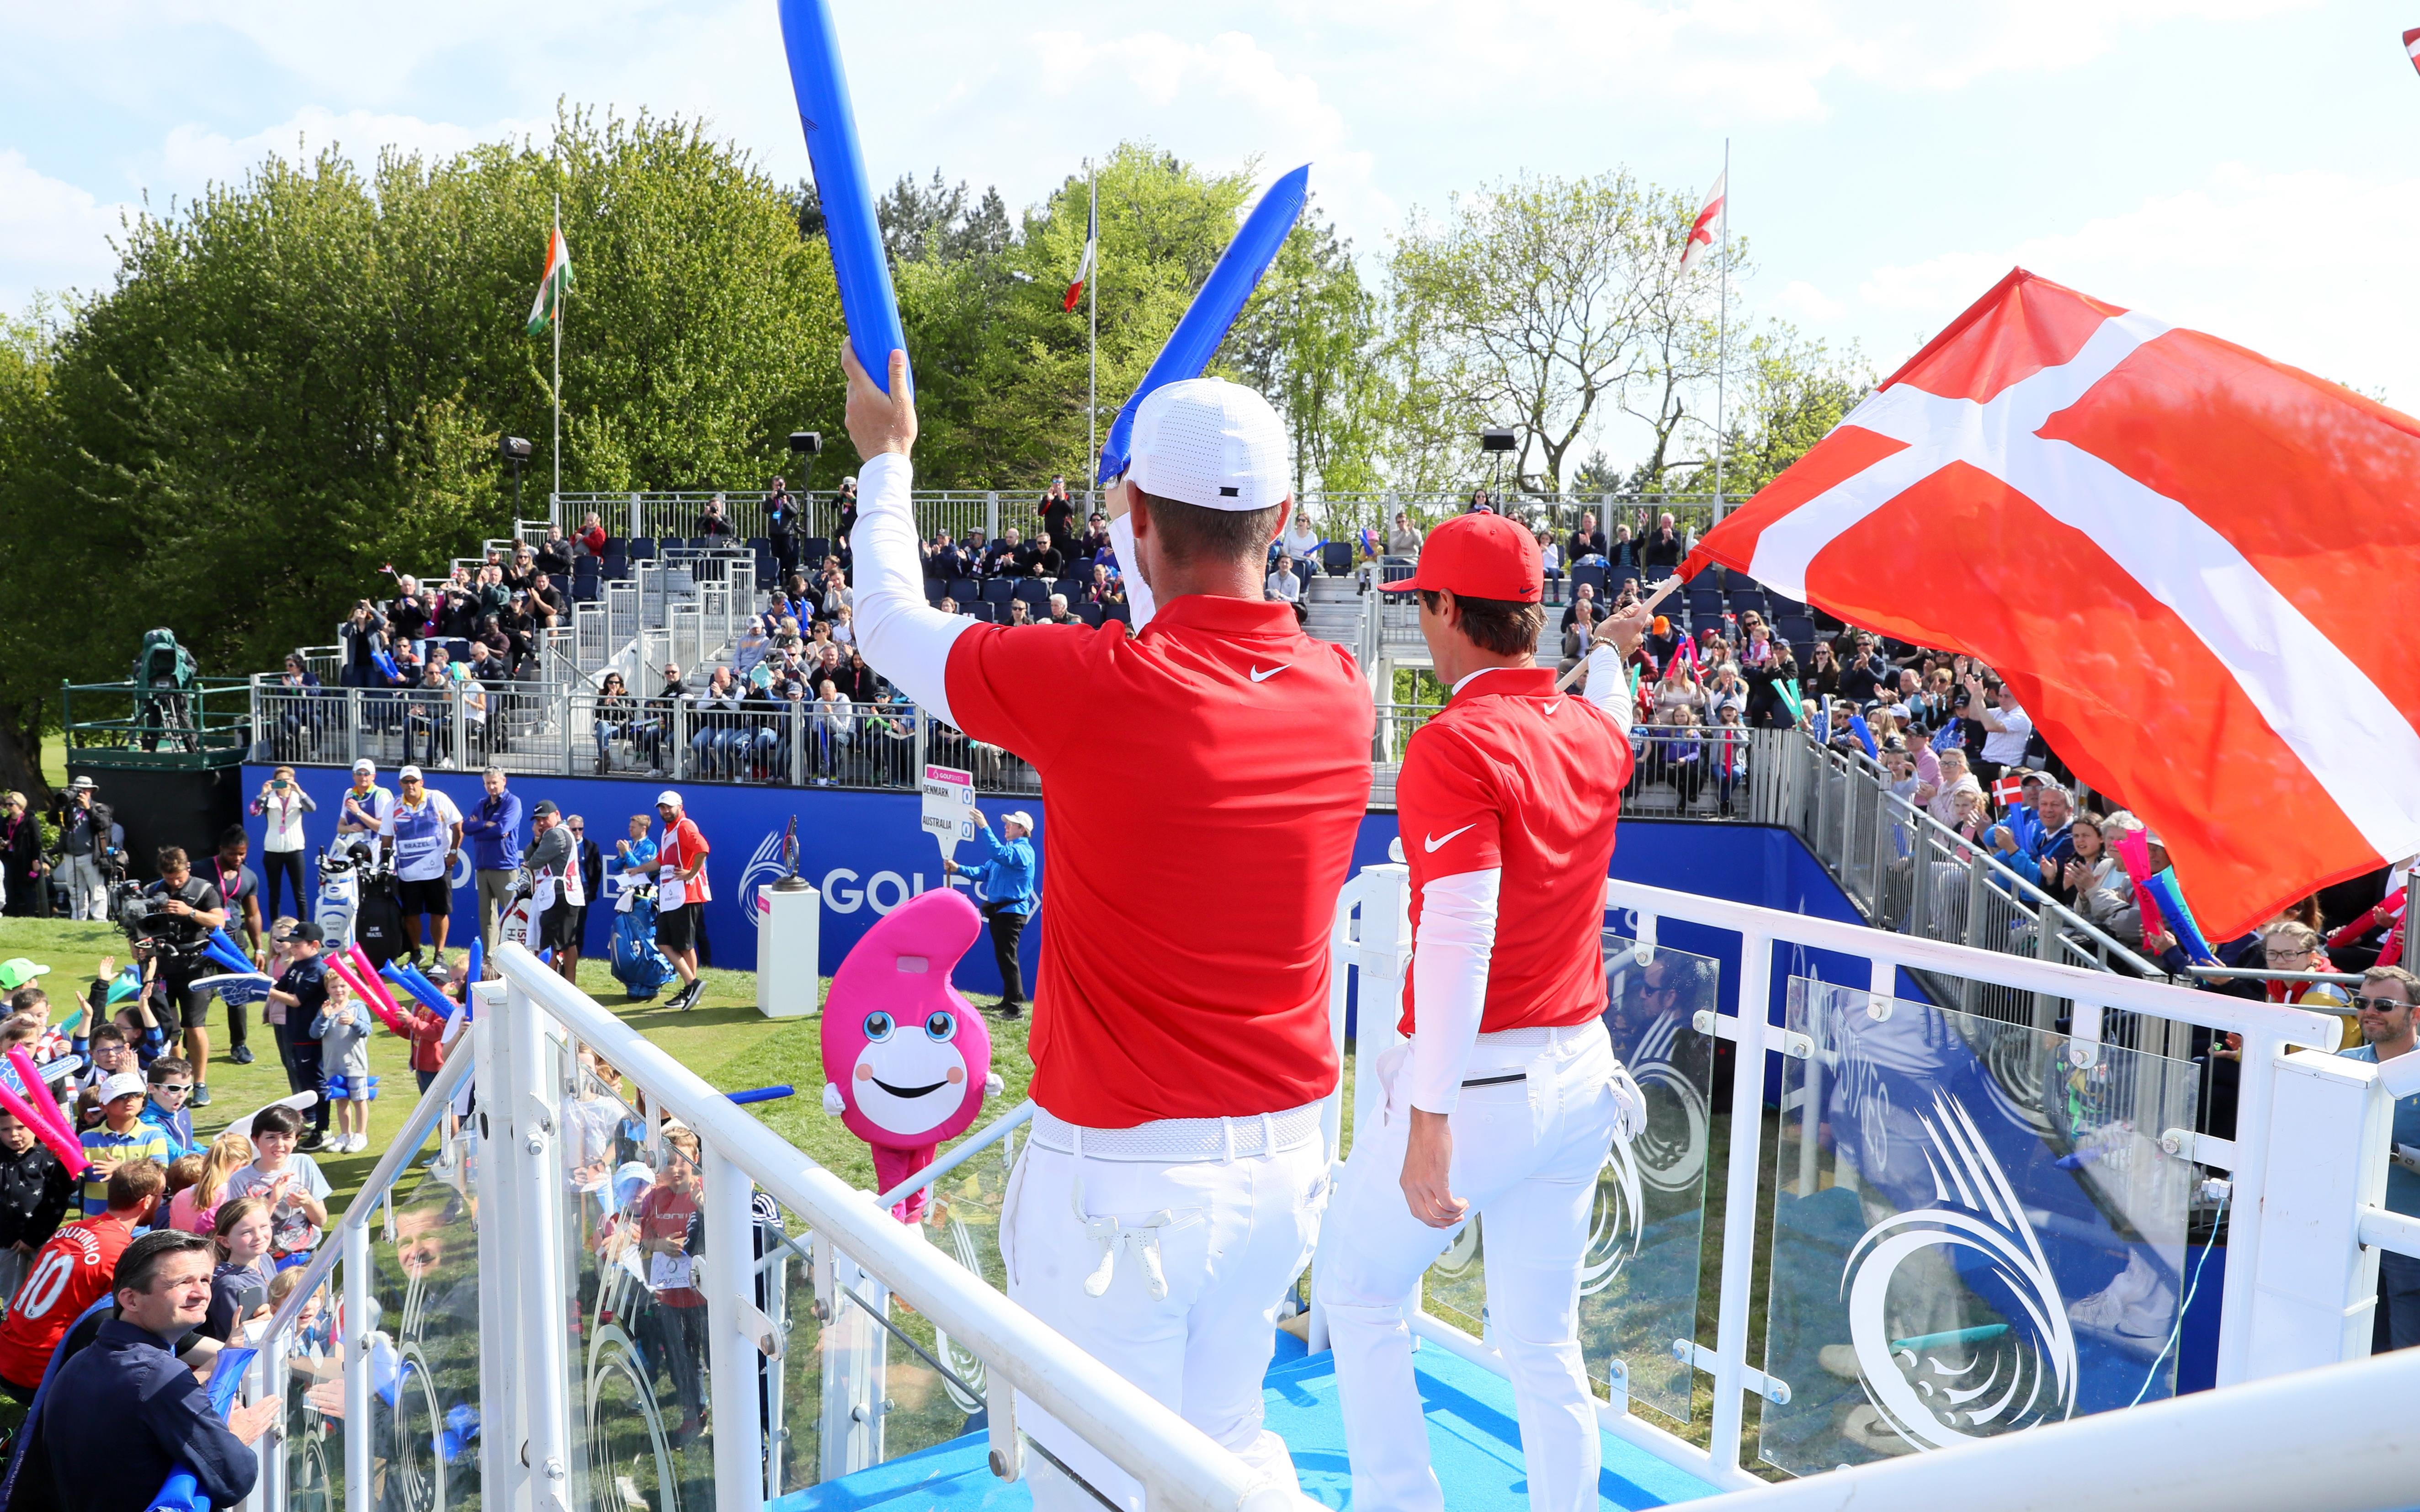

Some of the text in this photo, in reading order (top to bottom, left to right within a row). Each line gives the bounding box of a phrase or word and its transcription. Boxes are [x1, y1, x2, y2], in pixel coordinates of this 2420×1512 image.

[940, 773, 963, 782] GOLFSIXES
[923, 784, 972, 804] DENMARK 0
[922, 816, 971, 837] AUSTRALIA 0
[518, 928, 526, 946] ISP
[47, 1226, 101, 1265] OUTINHO
[13, 1248, 74, 1320] 10
[10, 1450, 24, 1484] EUROPEAN
